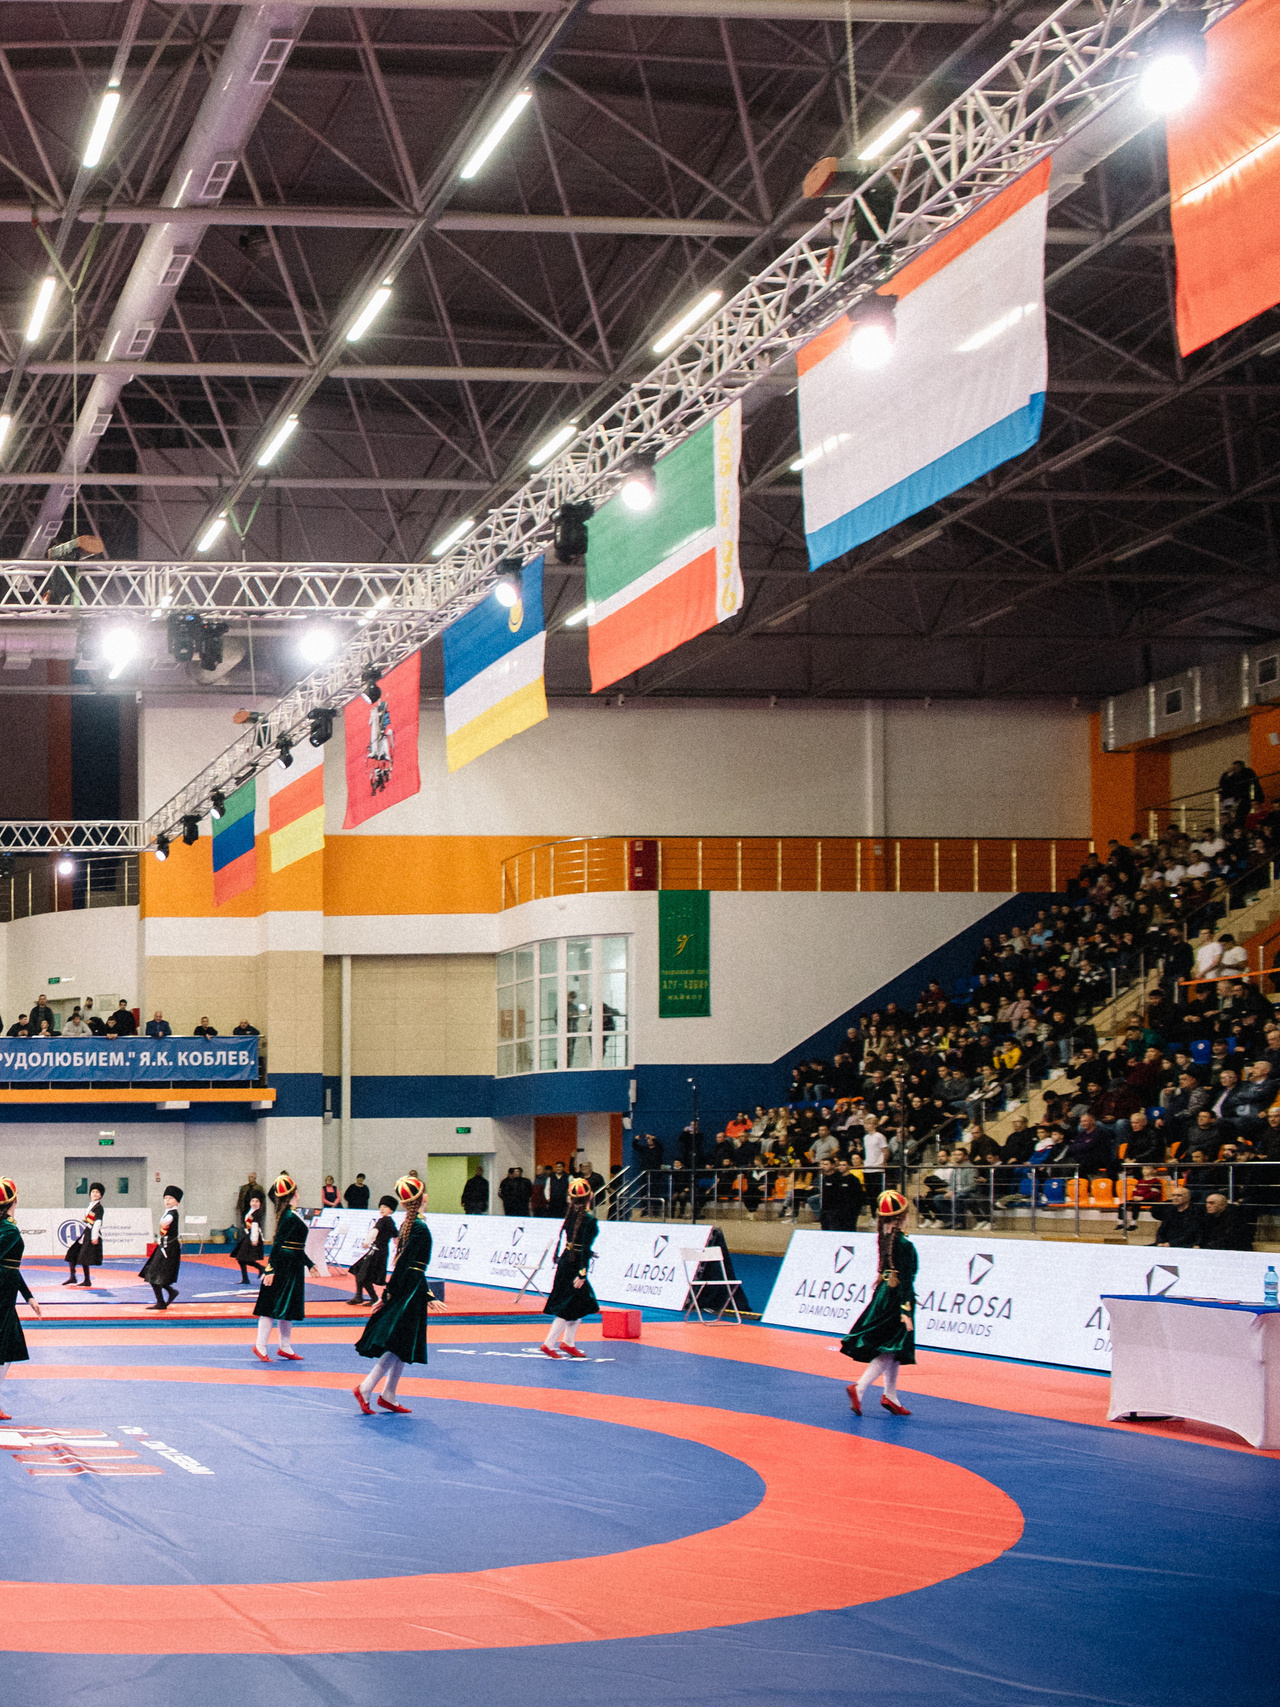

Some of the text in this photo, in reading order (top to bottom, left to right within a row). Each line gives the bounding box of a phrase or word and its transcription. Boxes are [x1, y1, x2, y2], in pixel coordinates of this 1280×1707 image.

[139, 1051, 174, 1067] Я.К.
[177, 1051, 255, 1067] КОБЛЕВ.
[438, 1246, 470, 1261] ALROSA
[489, 1250, 528, 1267] ALROSA
[624, 1262, 677, 1283] ALROSA
[794, 1278, 868, 1304] ALROSA
[798, 1302, 851, 1320] DIAMONDS
[921, 1290, 1013, 1320] ALROSA
[926, 1317, 994, 1338] DIAMONDS
